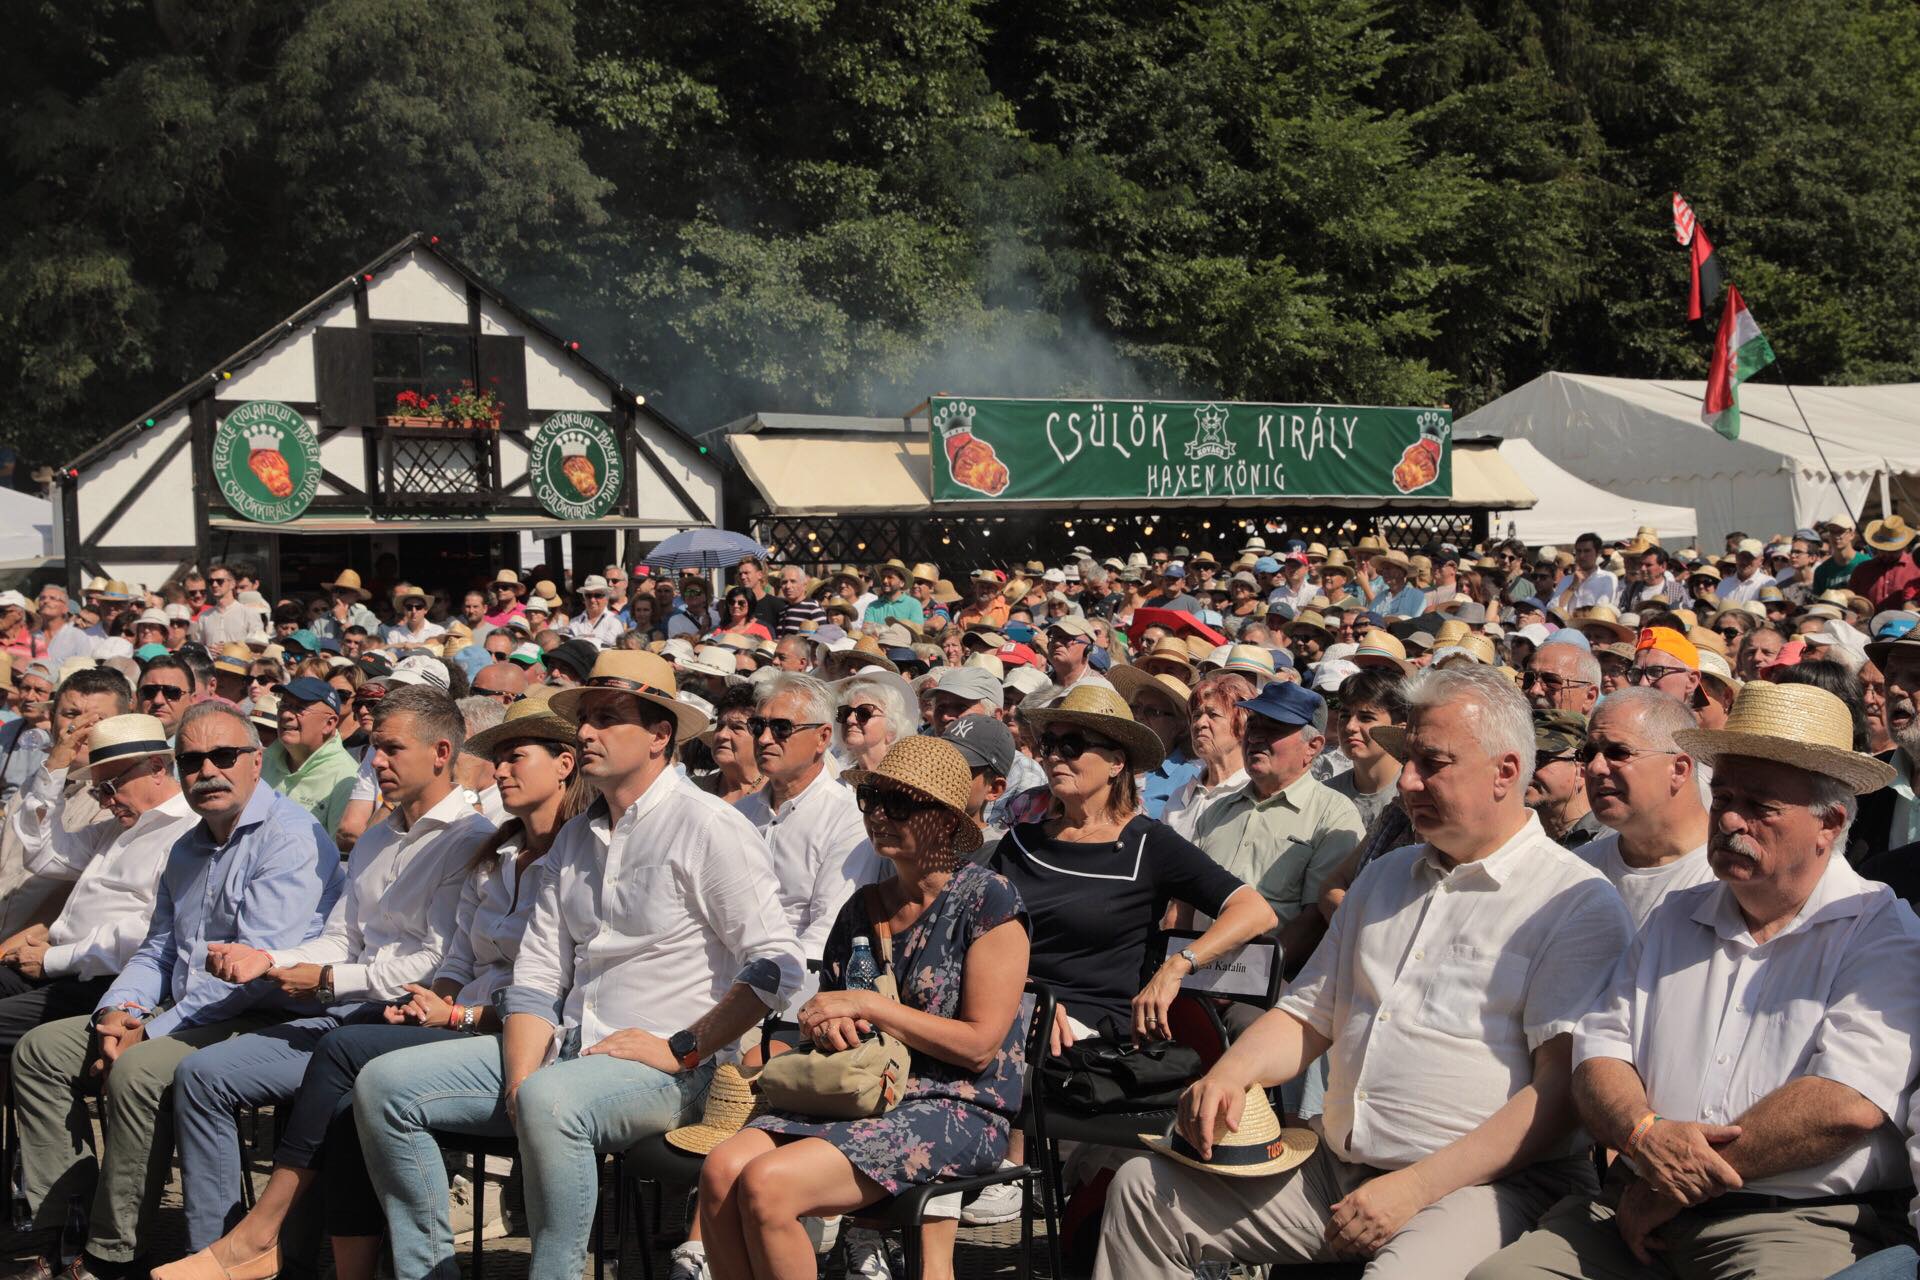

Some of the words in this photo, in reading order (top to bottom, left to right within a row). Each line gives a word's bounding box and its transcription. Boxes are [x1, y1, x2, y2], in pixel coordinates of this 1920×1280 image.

[216, 424, 237, 470] REGELE
[232, 403, 292, 427] CIOLANULUI
[294, 423, 320, 463] HAXEN
[531, 433, 549, 478] REGELE
[544, 412, 594, 436] CIOLANULUI
[597, 429, 619, 465] HAXEN
[1046, 403, 1169, 464] CSÜLÖK
[1258, 406, 1358, 461] KIRÁLY
[602, 469, 620, 502] KÖNIG
[1147, 464, 1216, 496] HAXEN
[1224, 459, 1285, 496] KÖNIG
[950, 719, 974, 738] NY
[1215, 960, 1247, 972] Katalin
